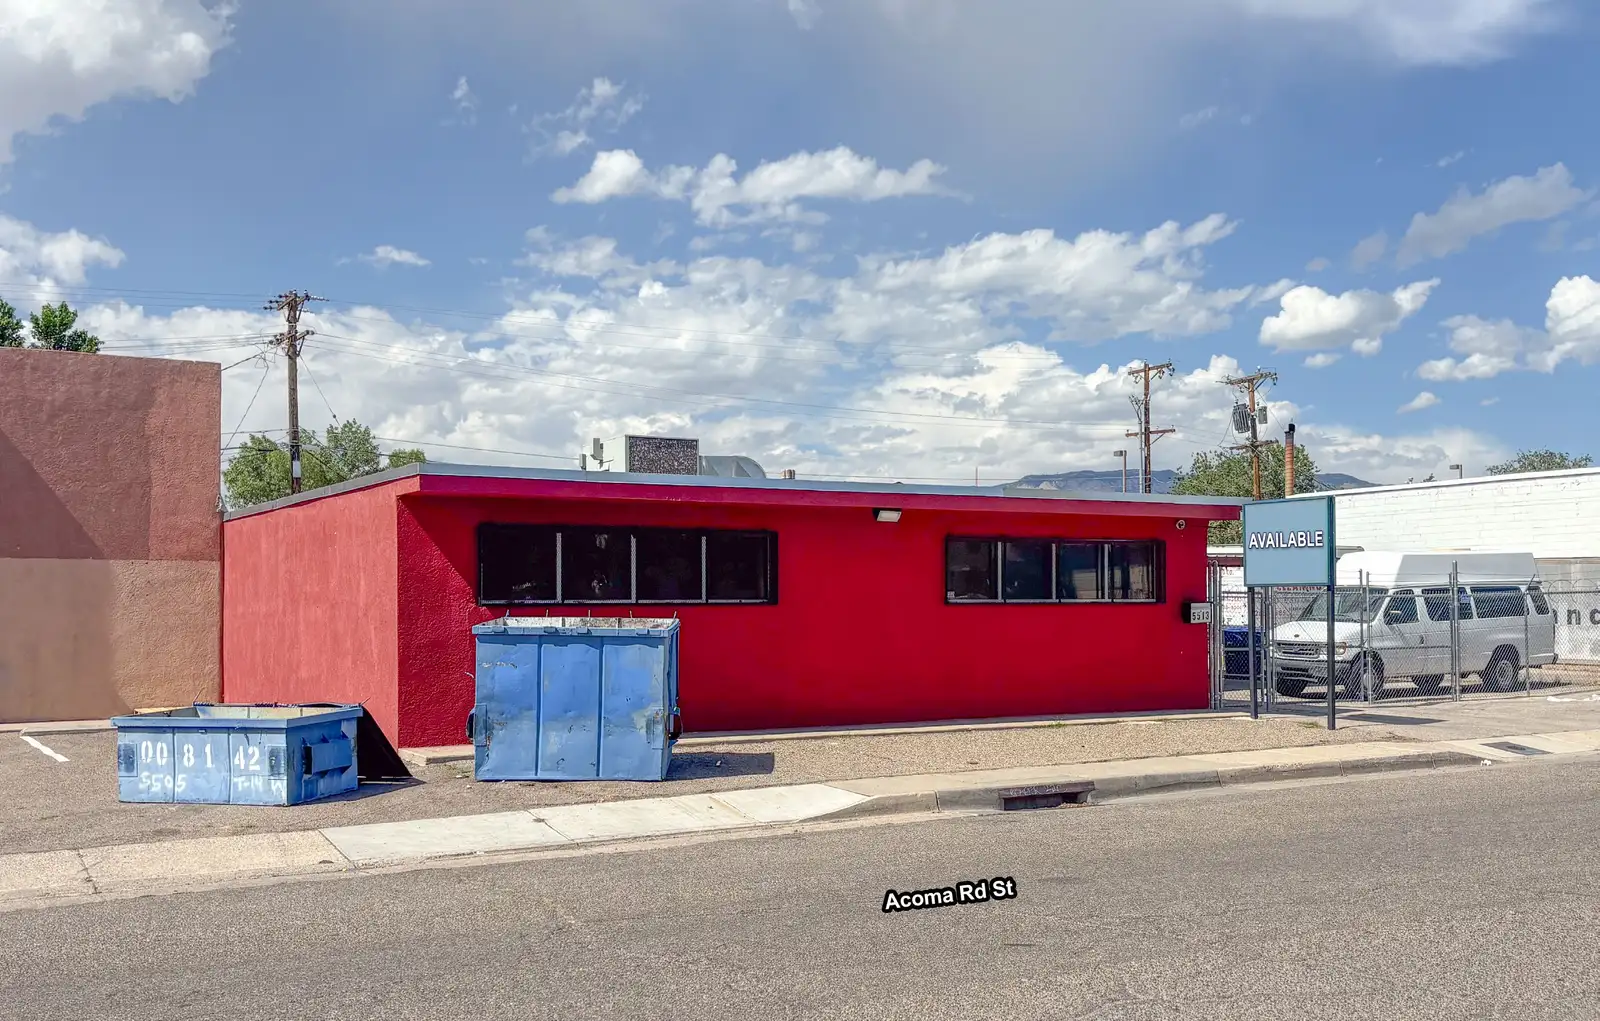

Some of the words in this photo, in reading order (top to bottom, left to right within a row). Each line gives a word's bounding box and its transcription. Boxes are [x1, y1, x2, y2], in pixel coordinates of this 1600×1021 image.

[1248, 530, 1323, 549] AVAILABLE
[1191, 610, 1210, 621] 5513
[140, 740, 168, 766] 00
[234, 745, 260, 771] 42
